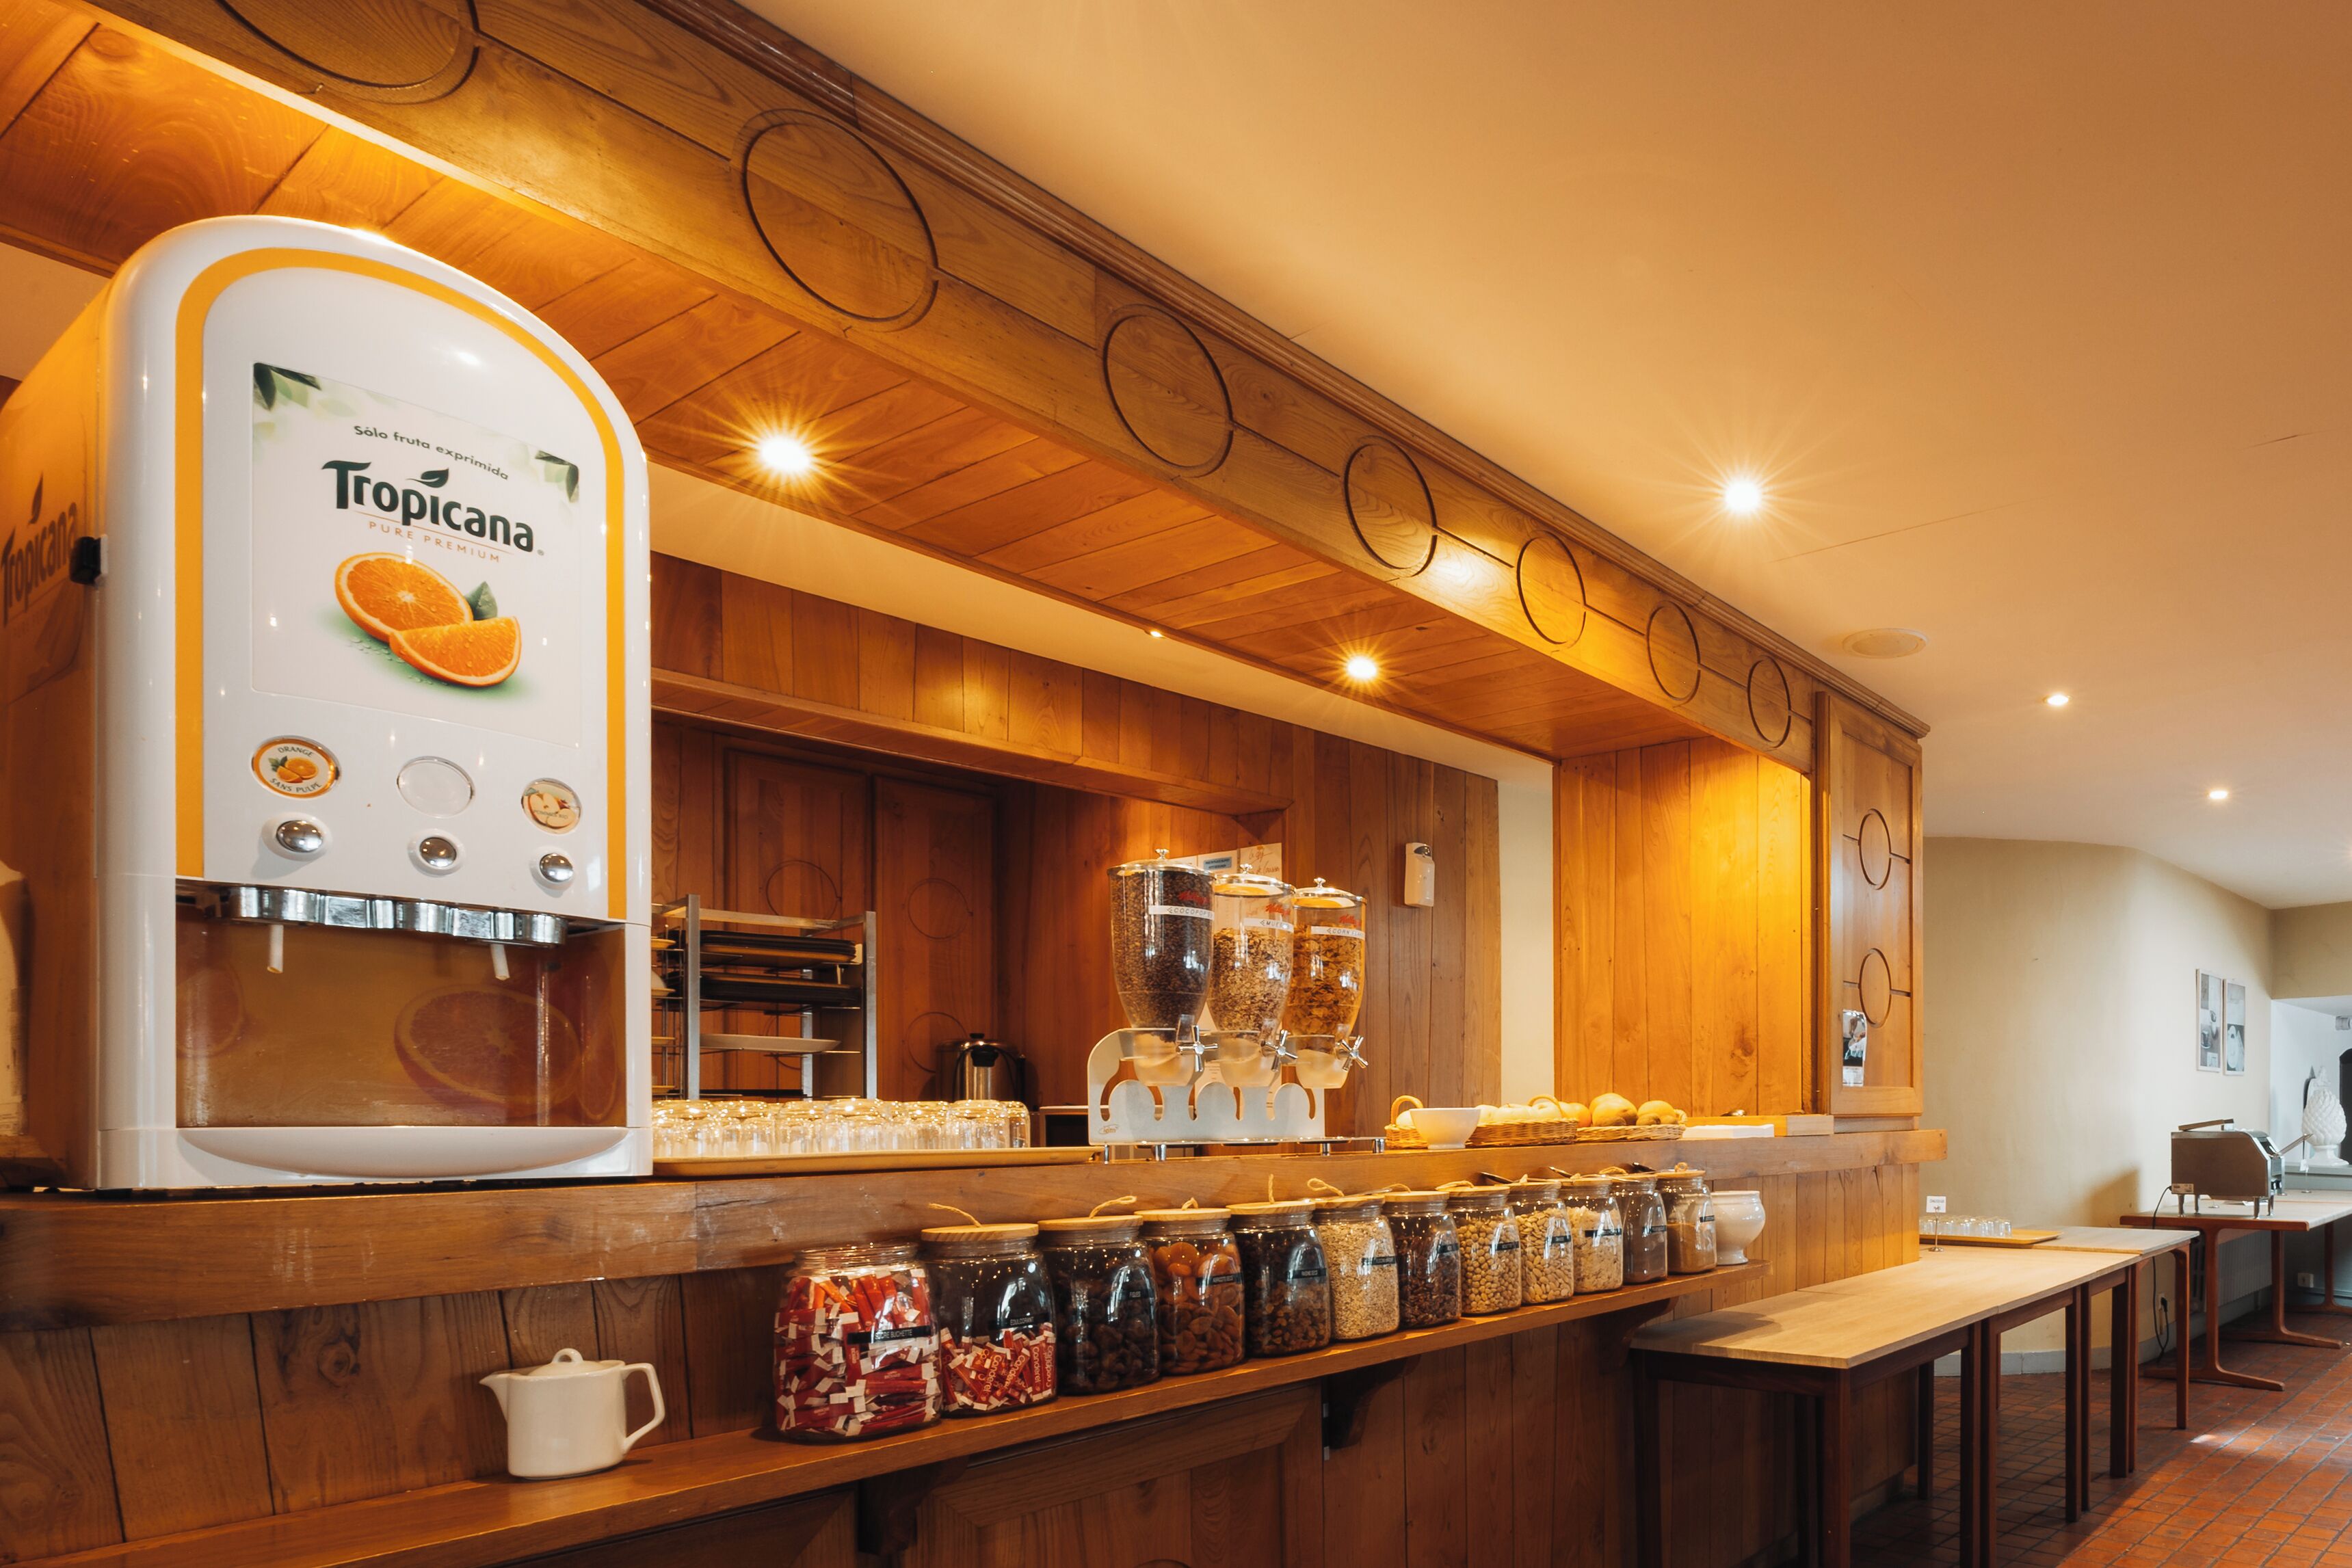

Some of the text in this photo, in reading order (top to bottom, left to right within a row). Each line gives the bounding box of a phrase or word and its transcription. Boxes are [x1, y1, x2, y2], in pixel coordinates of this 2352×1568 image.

[354, 425, 509, 480] Sólo fruta exprimida
[321, 460, 533, 553] Tropicana
[369, 521, 499, 563] PURE PREMIUM
[278, 746, 314, 757] ORANGE
[270, 778, 292, 792] SANS
[983, 1355, 1002, 1392] Canderel
[1033, 1346, 1041, 1383] Canderel
